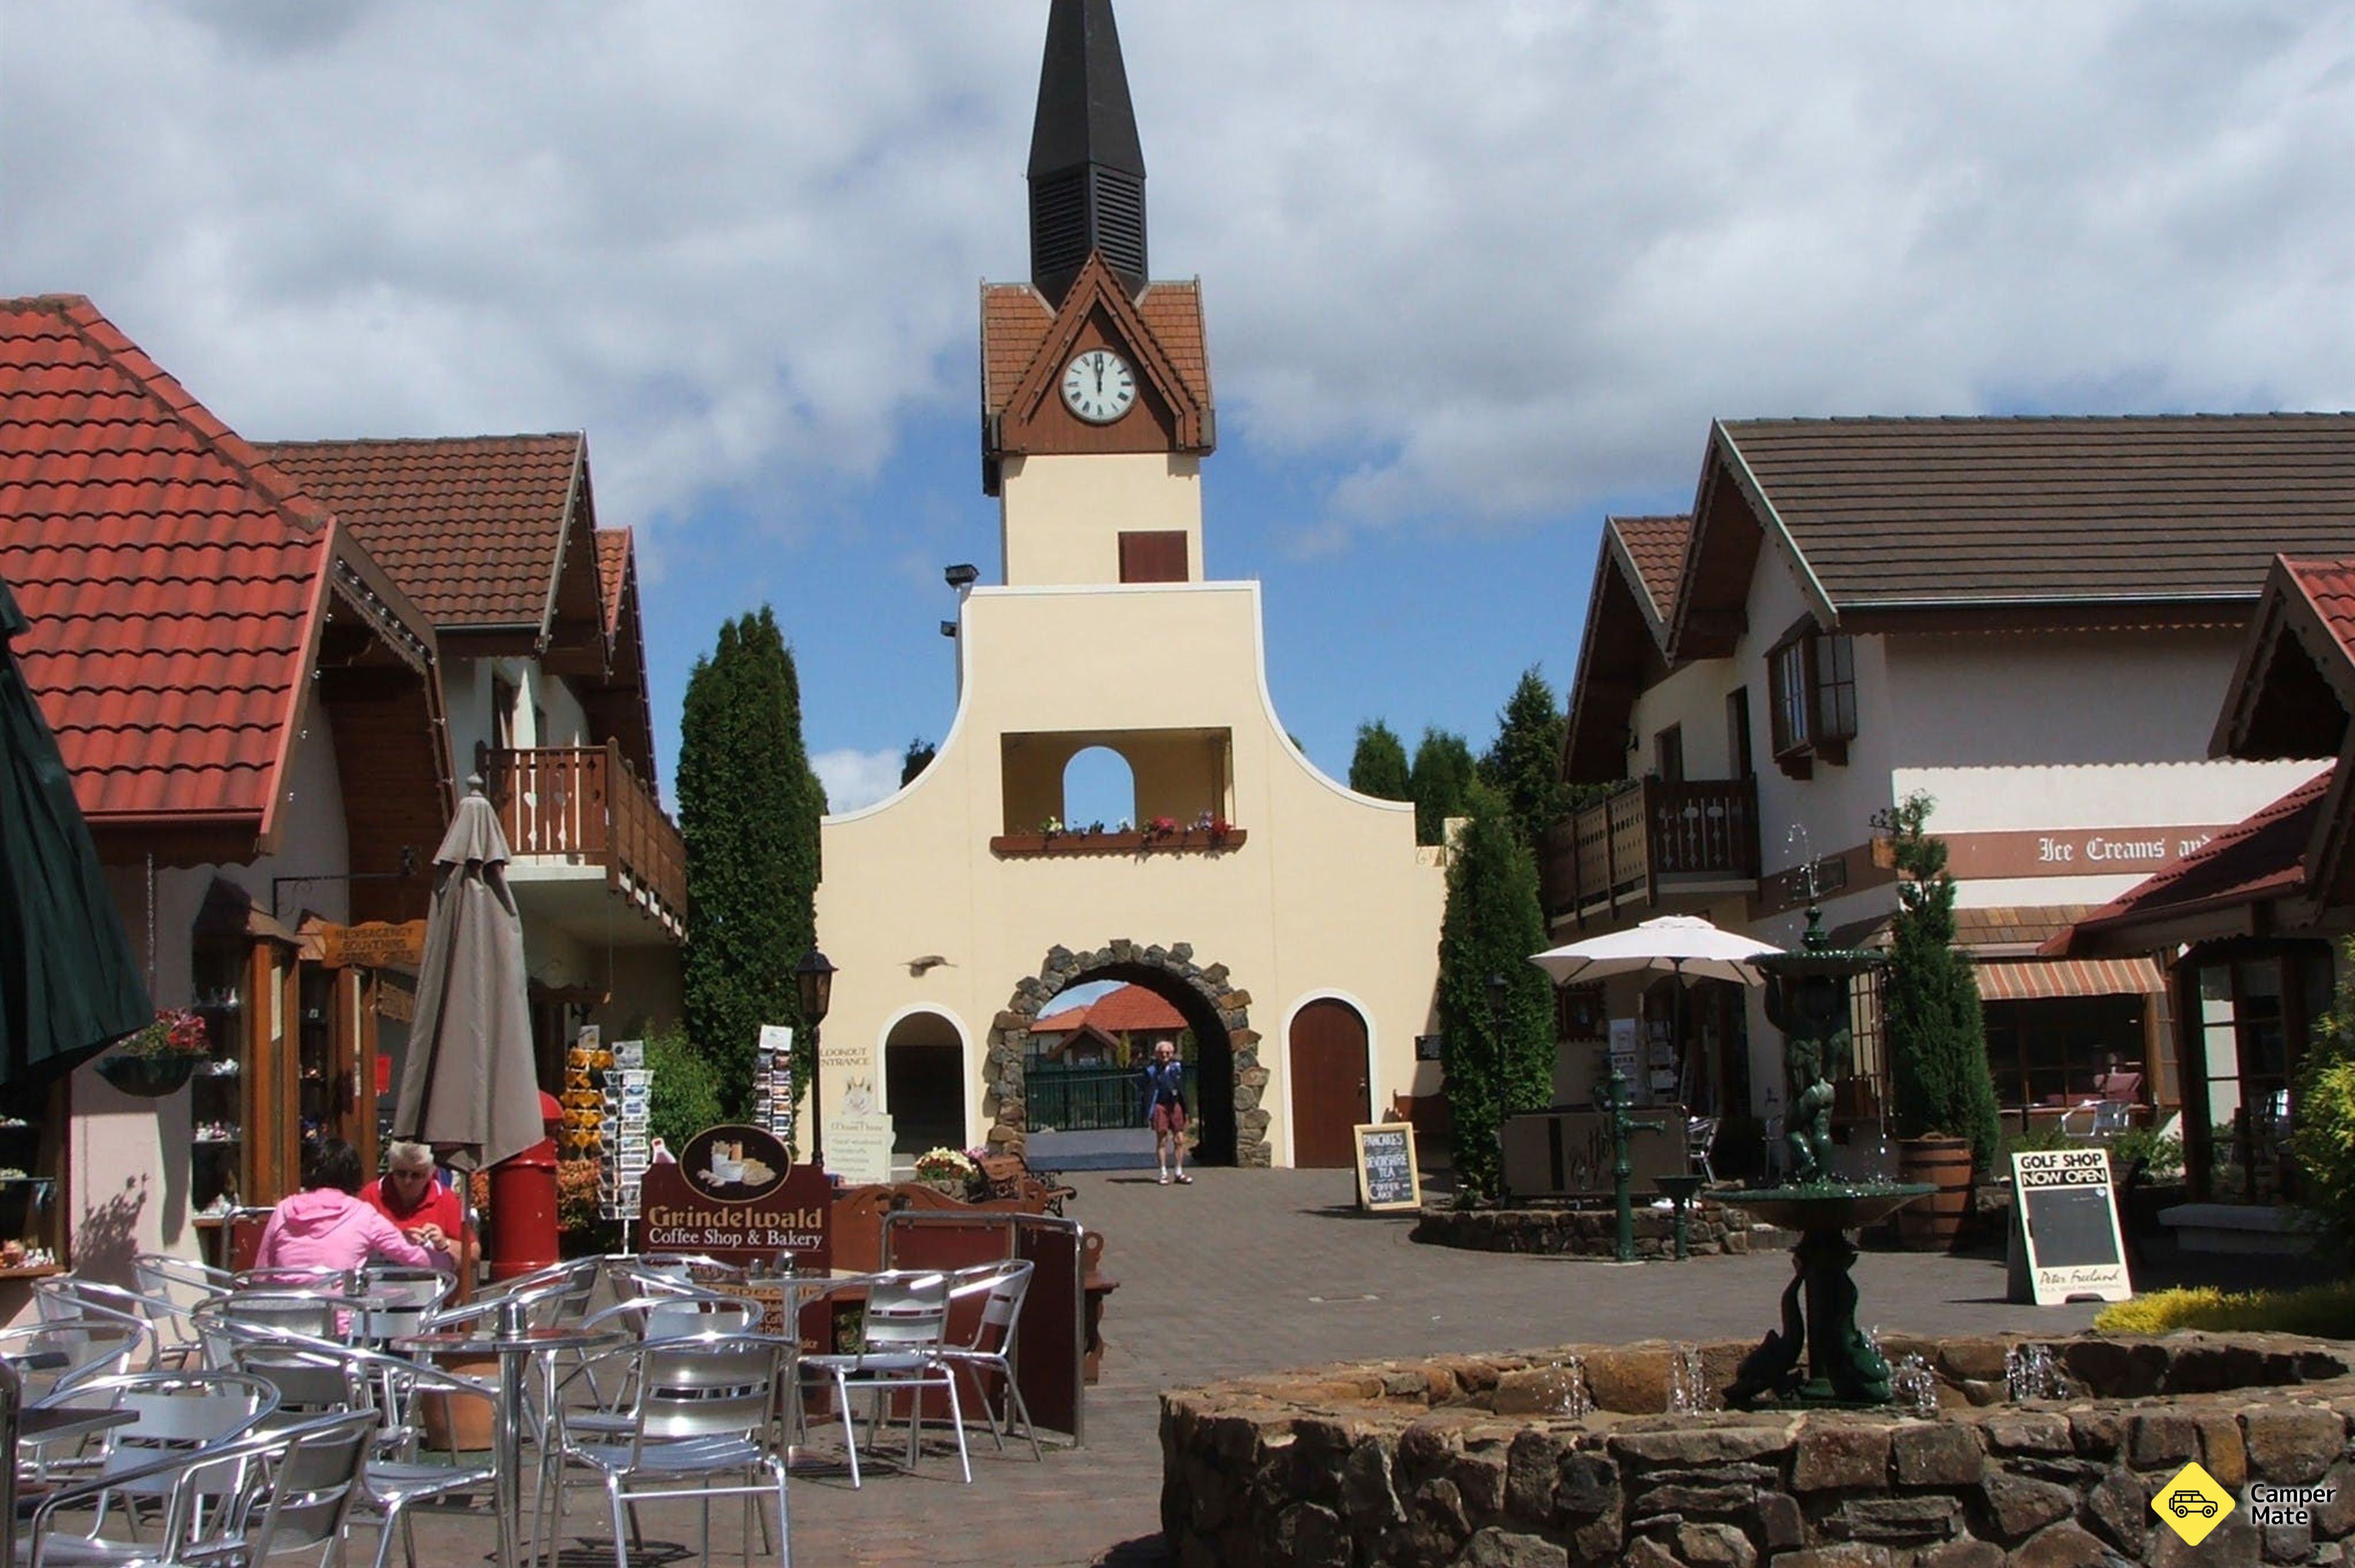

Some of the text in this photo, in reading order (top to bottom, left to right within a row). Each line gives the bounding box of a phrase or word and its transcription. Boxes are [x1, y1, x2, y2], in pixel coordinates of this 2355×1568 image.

[2039, 837, 2074, 862] Ice
[2087, 836, 2166, 861] Creams
[820, 1058, 870, 1067] NTRANCE
[2021, 1153, 2102, 1168] GOLF SHOP
[1378, 1167, 1396, 1179] TEA
[2021, 1170, 2105, 1185] NOW OPEN
[648, 1205, 822, 1229] Grindelwald
[649, 1228, 823, 1249] Coffee Shop & Bakery
